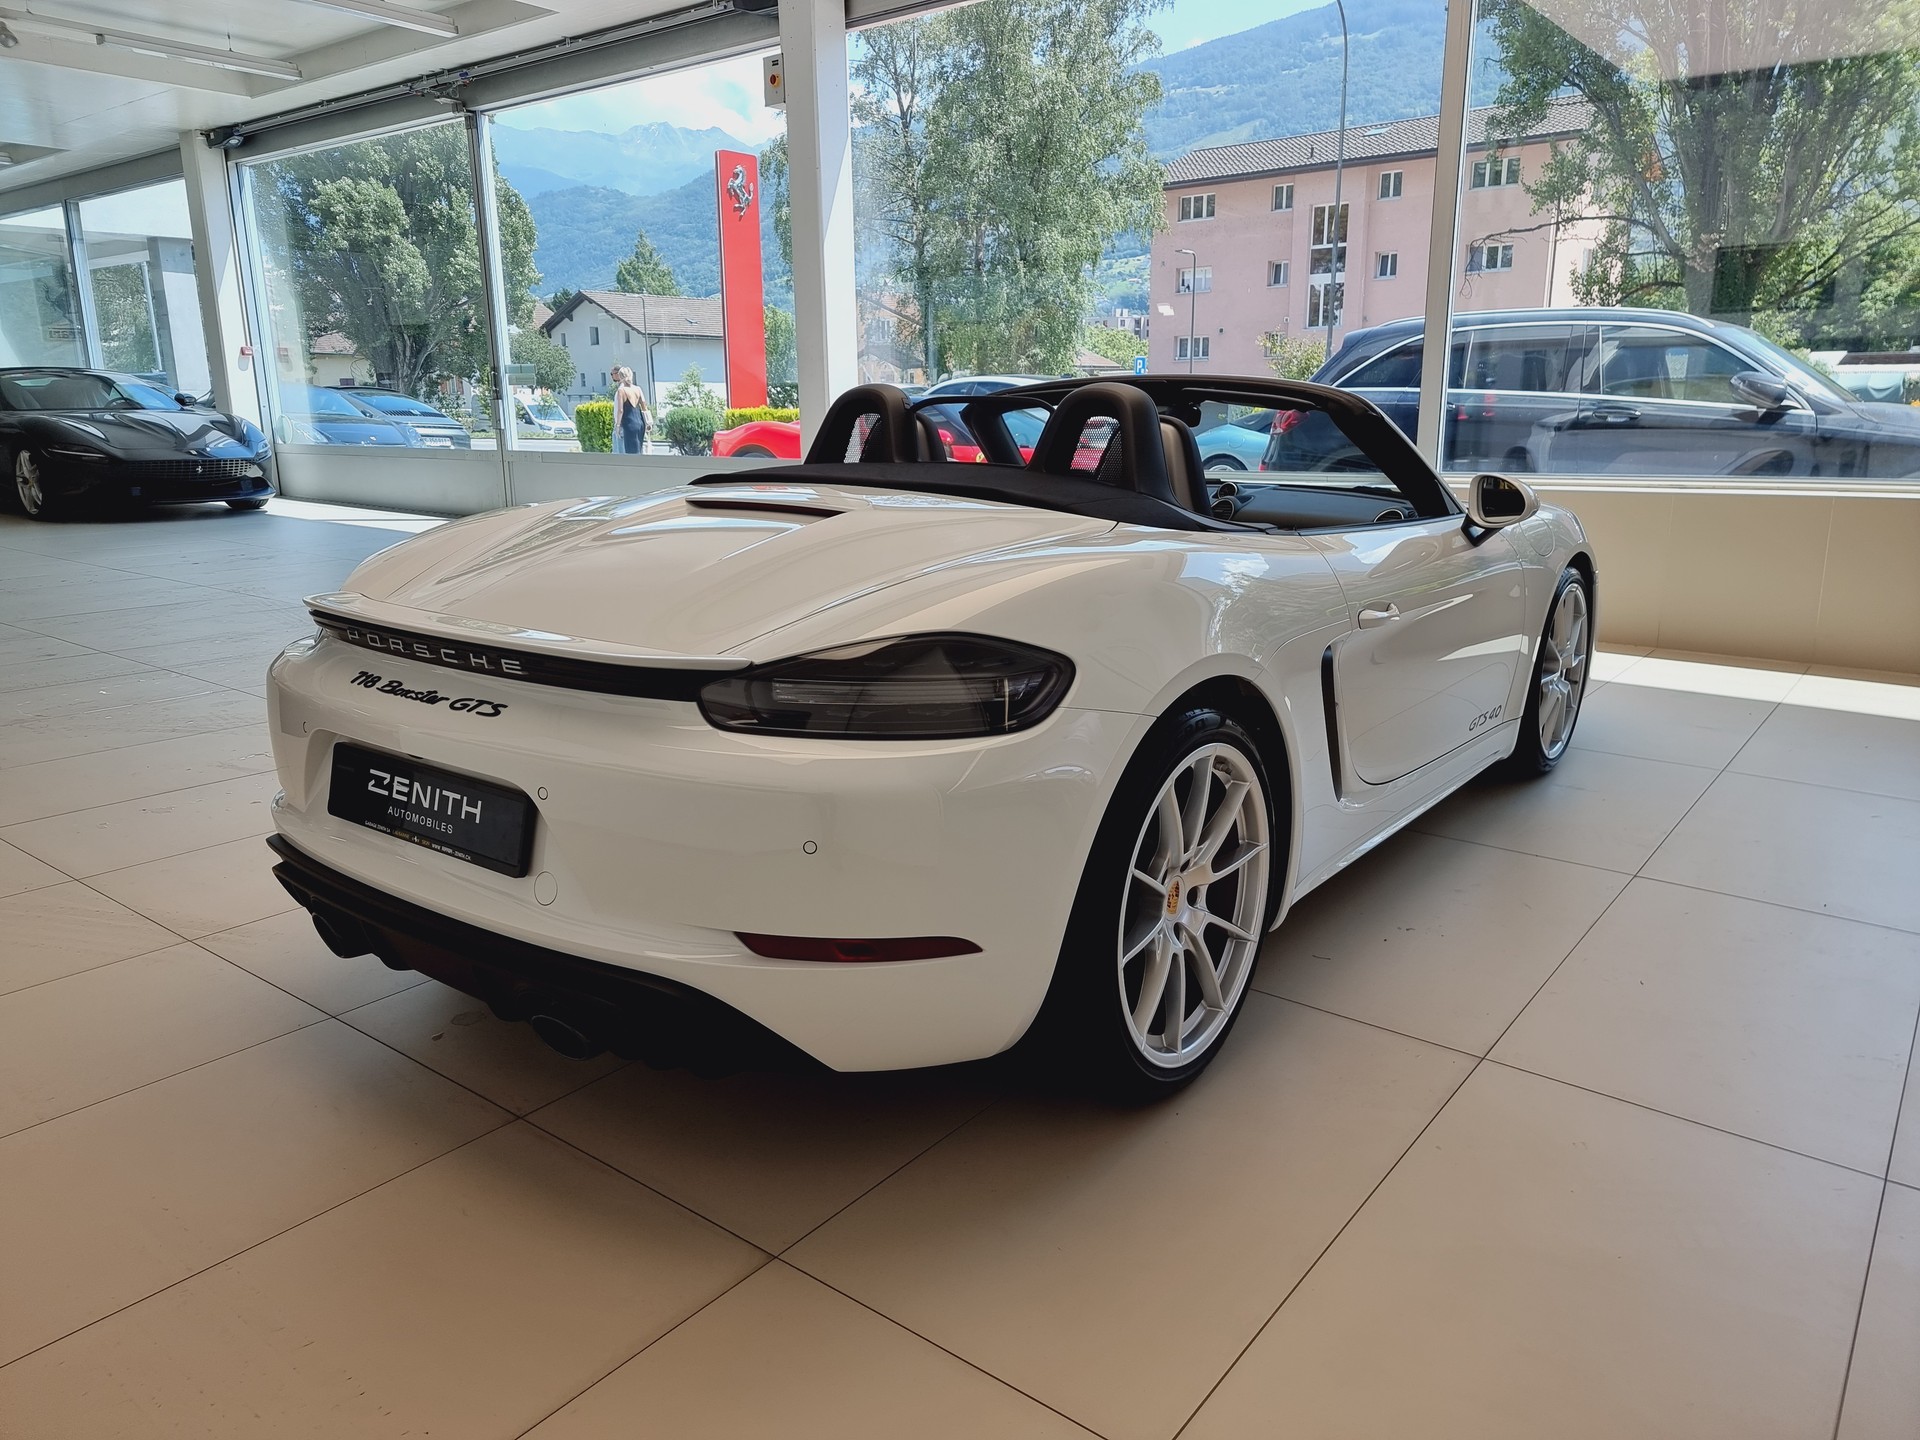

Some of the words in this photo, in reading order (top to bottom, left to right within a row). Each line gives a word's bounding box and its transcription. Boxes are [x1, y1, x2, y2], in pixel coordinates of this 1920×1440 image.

[346, 629, 522, 675] PORSCHE
[350, 670, 382, 689] 718
[376, 680, 450, 706] Boxster
[448, 697, 508, 718] GTS
[1468, 710, 1489, 732] GTS
[367, 768, 482, 824] ZENITH
[387, 805, 453, 834] AUTOMOBILES
